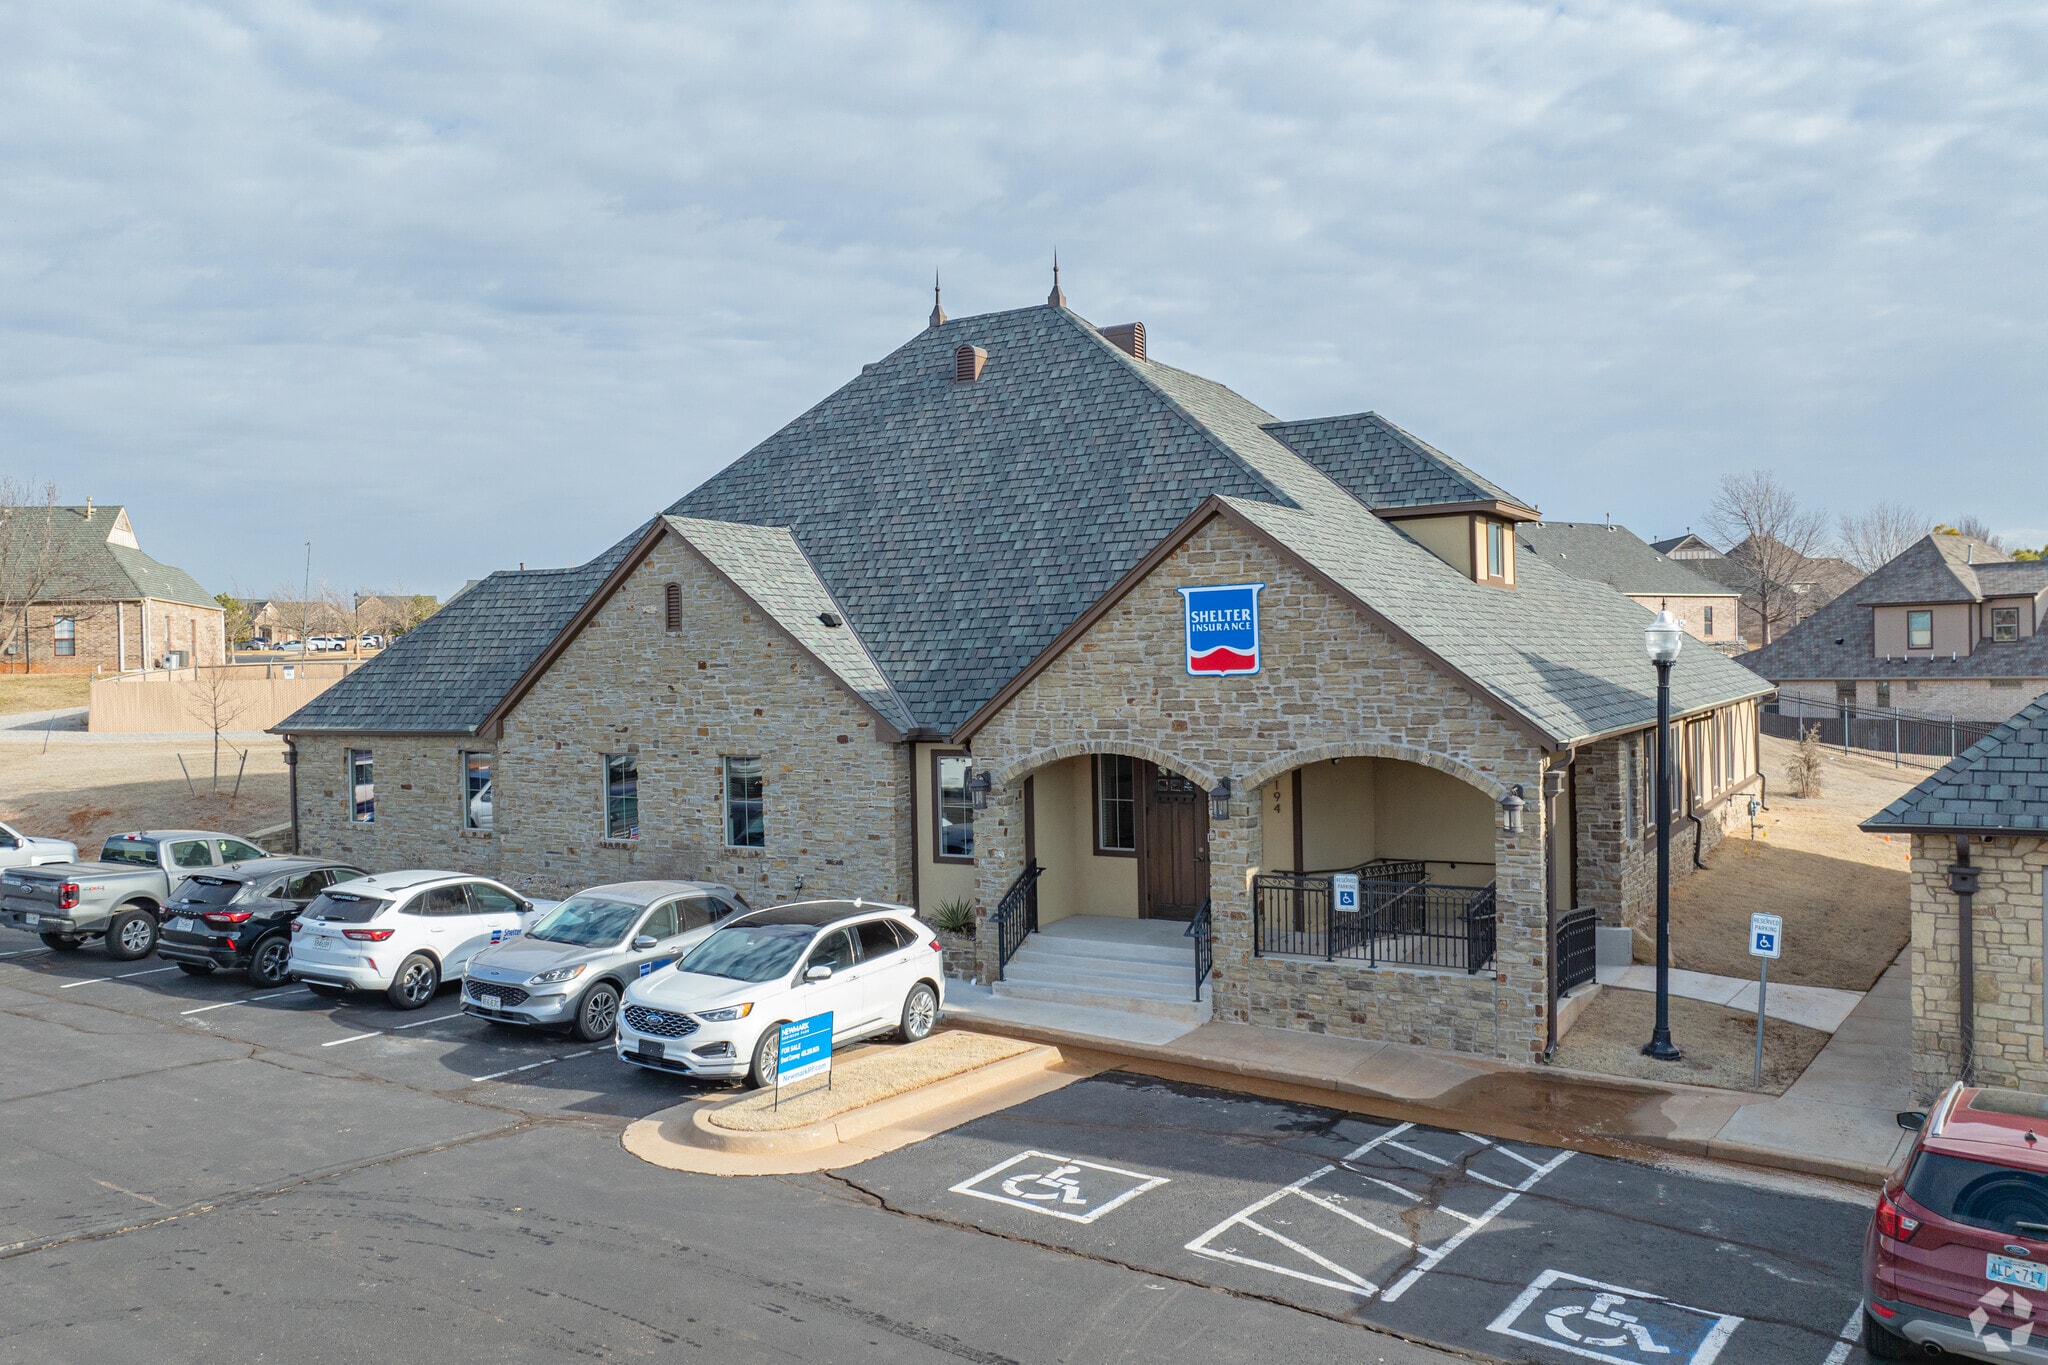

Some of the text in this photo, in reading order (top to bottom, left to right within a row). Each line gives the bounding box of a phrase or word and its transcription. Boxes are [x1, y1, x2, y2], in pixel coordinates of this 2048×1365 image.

[1191, 608, 1252, 624] SHELTER
[1192, 621, 1252, 633] INSURANCE
[1273, 780, 1281, 814] 194
[1753, 917, 1780, 926] RESERVED
[1754, 924, 1778, 933] PARKING
[782, 1022, 810, 1037] NEWMARK
[781, 1046, 791, 1055] FOR
[791, 1042, 802, 1052] SALE
[782, 1062, 827, 1082] NewmarkRP.com
